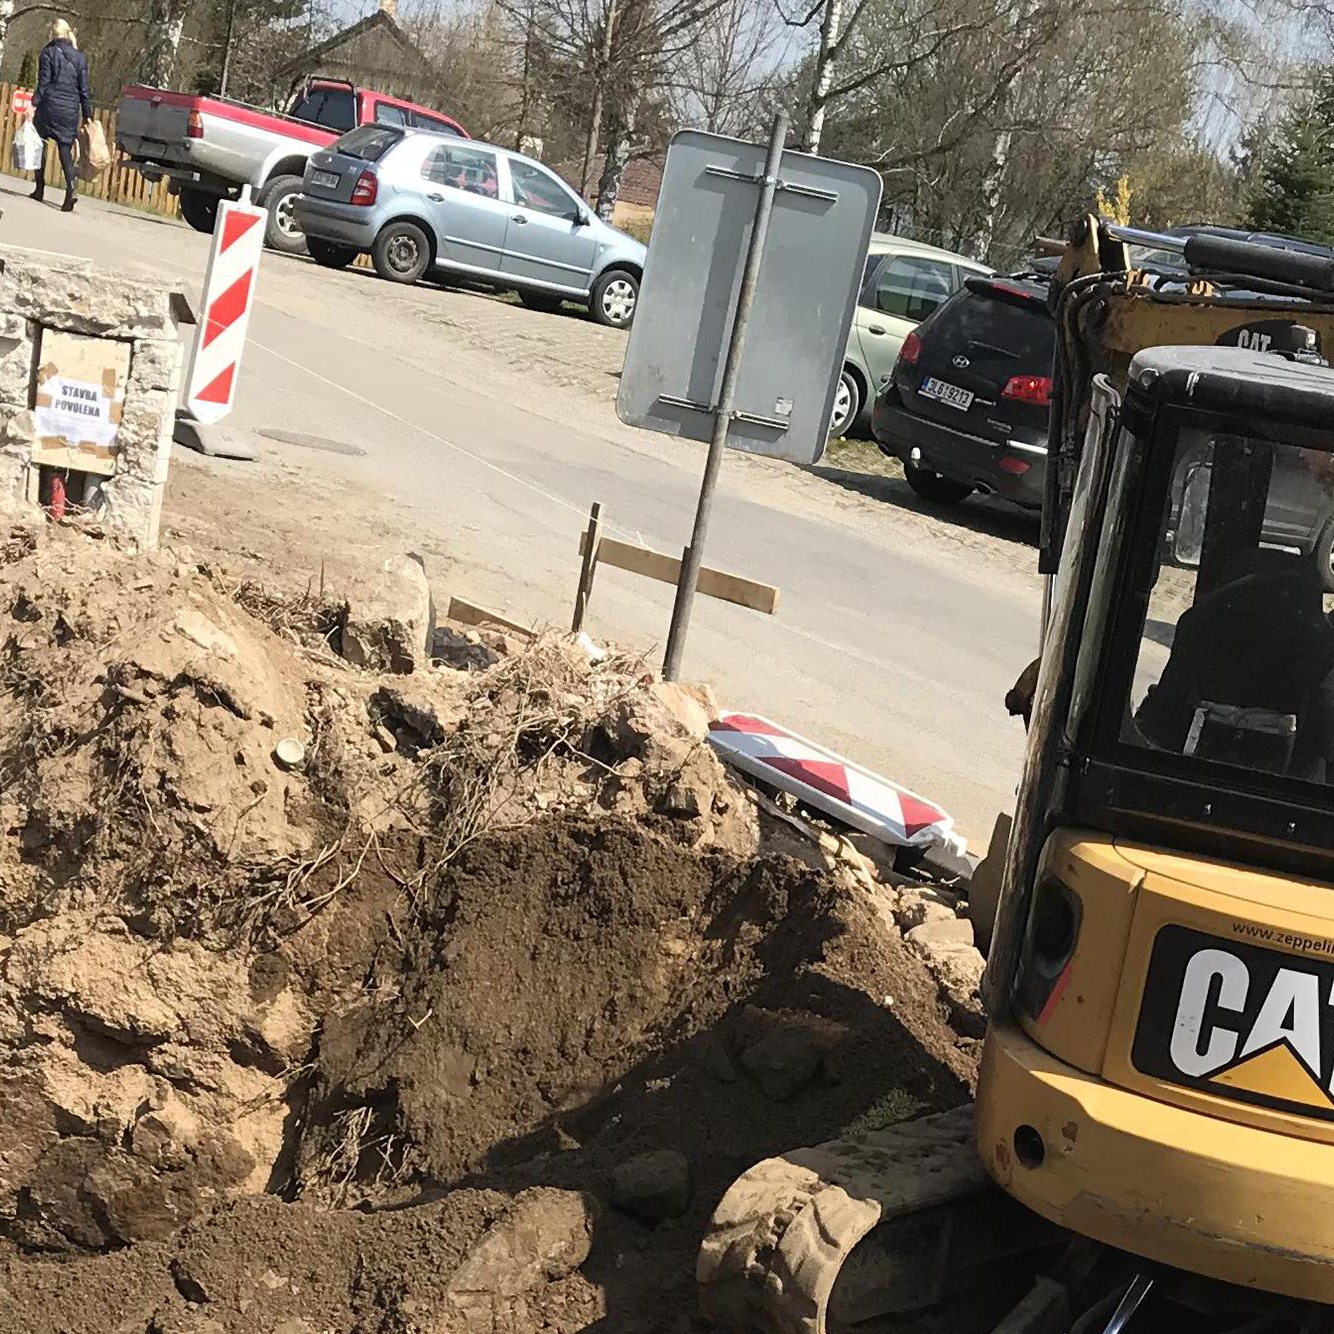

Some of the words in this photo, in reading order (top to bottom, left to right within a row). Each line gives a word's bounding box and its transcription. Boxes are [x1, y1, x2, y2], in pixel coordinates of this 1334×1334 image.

[1238, 329, 1272, 353] CAT
[62, 385, 97, 402] STAVBA
[928, 380, 944, 395] 3L6
[947, 387, 970, 404] 9213
[55, 400, 100, 417] POVOLENA
